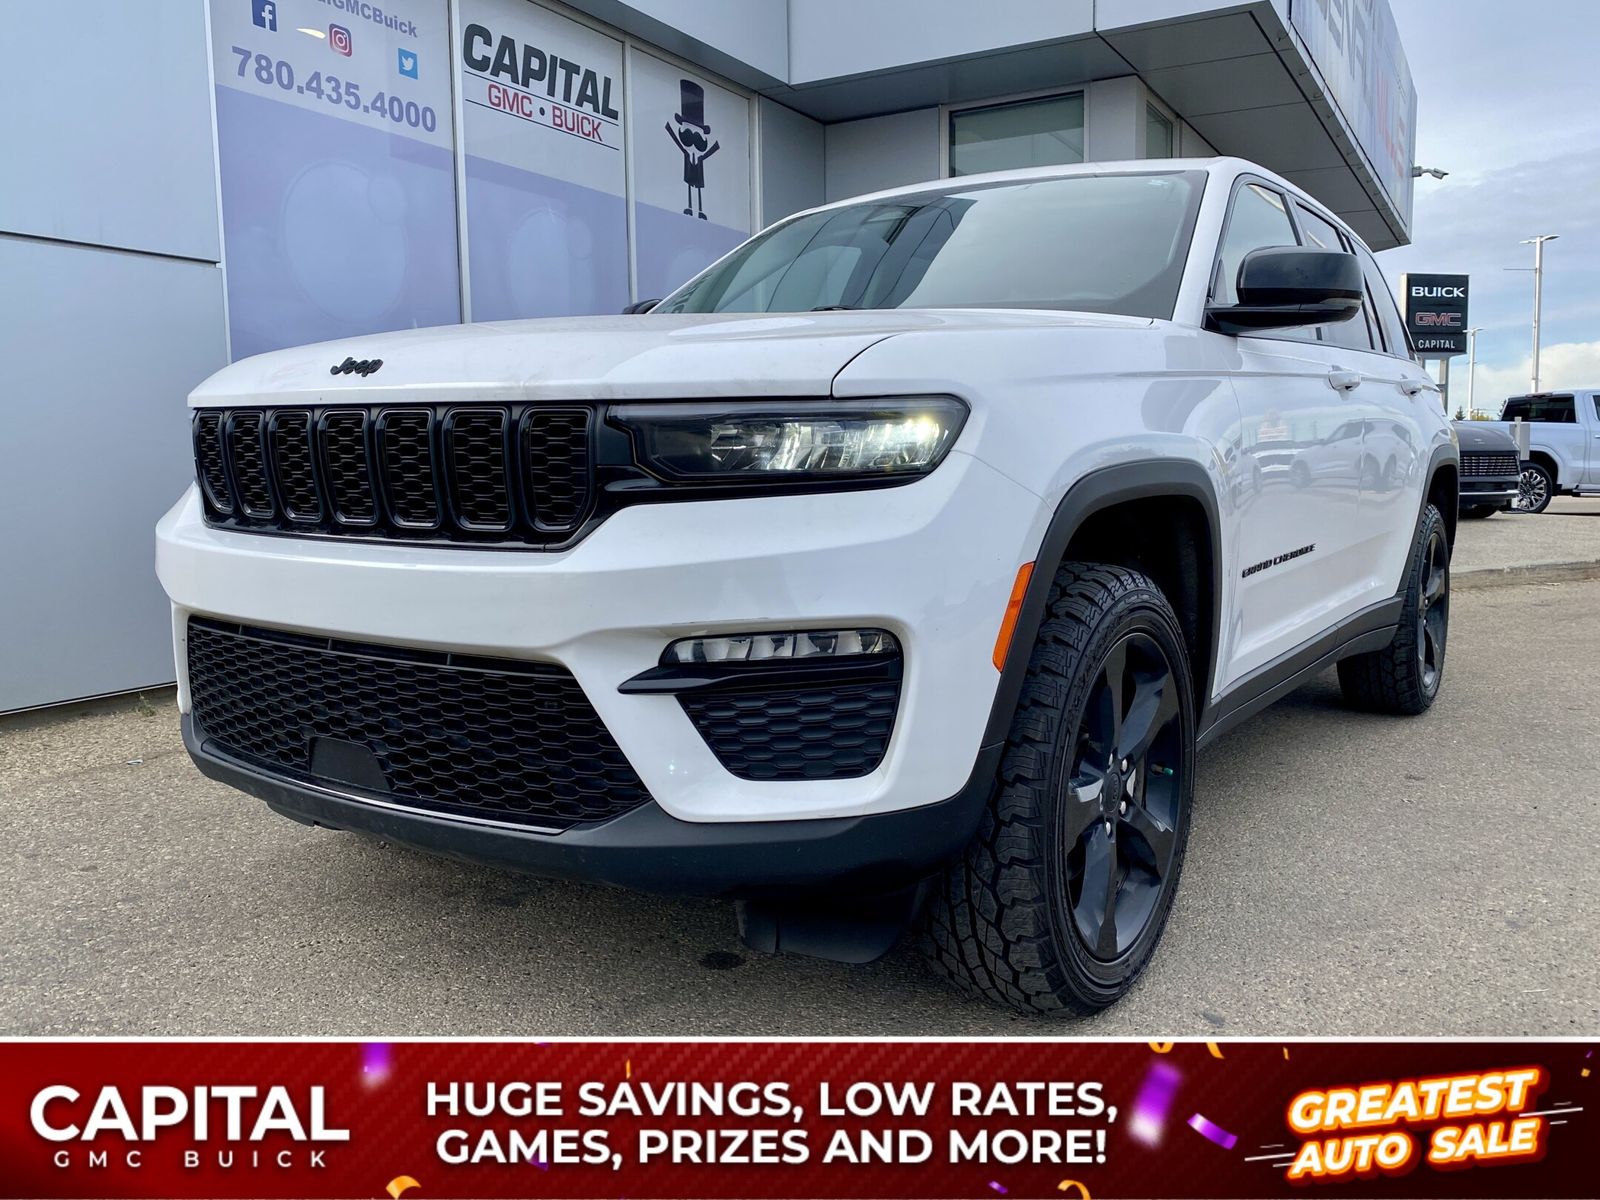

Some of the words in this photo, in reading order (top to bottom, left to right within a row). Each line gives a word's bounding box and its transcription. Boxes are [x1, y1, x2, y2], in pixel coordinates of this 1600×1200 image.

[317, 0, 418, 38] GMCBuick
[463, 23, 619, 121] CAPITAL
[231, 45, 437, 133] 780.435.4000
[487, 83, 533, 118] GMC
[551, 104, 603, 142] BUICK
[1411, 286, 1465, 298] BUICK
[1415, 312, 1461, 326] GMC
[1418, 339, 1455, 349] CAPITAL
[330, 356, 384, 378] Jeep
